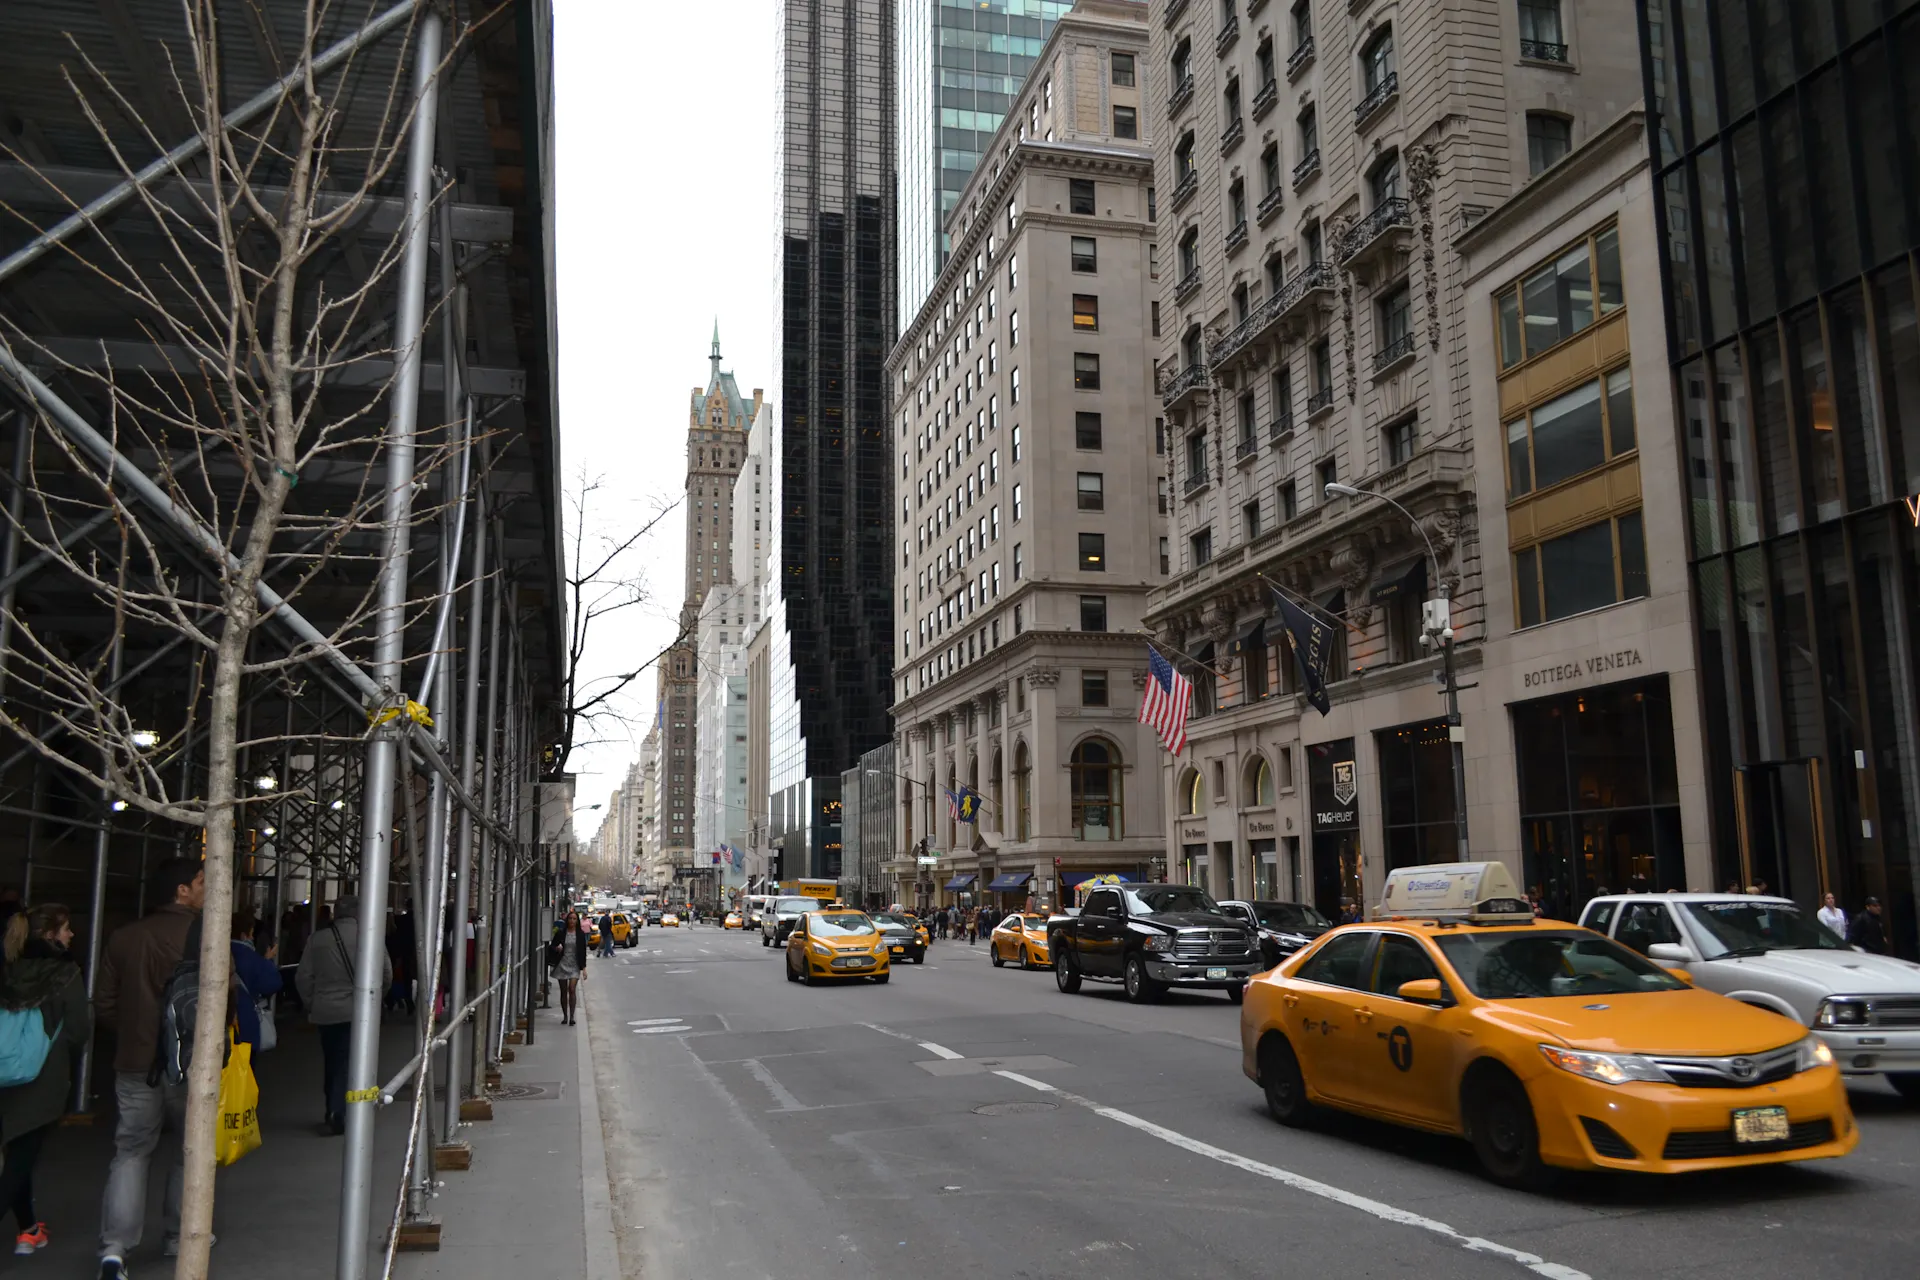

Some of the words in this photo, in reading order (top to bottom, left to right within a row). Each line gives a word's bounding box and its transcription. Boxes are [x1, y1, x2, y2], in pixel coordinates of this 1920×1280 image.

[1308, 623, 1322, 673] EGIS
[1524, 662, 1582, 687] BOTTEGA
[1586, 649, 1643, 674] VENETA
[1337, 766, 1352, 783] TAG
[1414, 880, 1452, 892] StreetEasy
